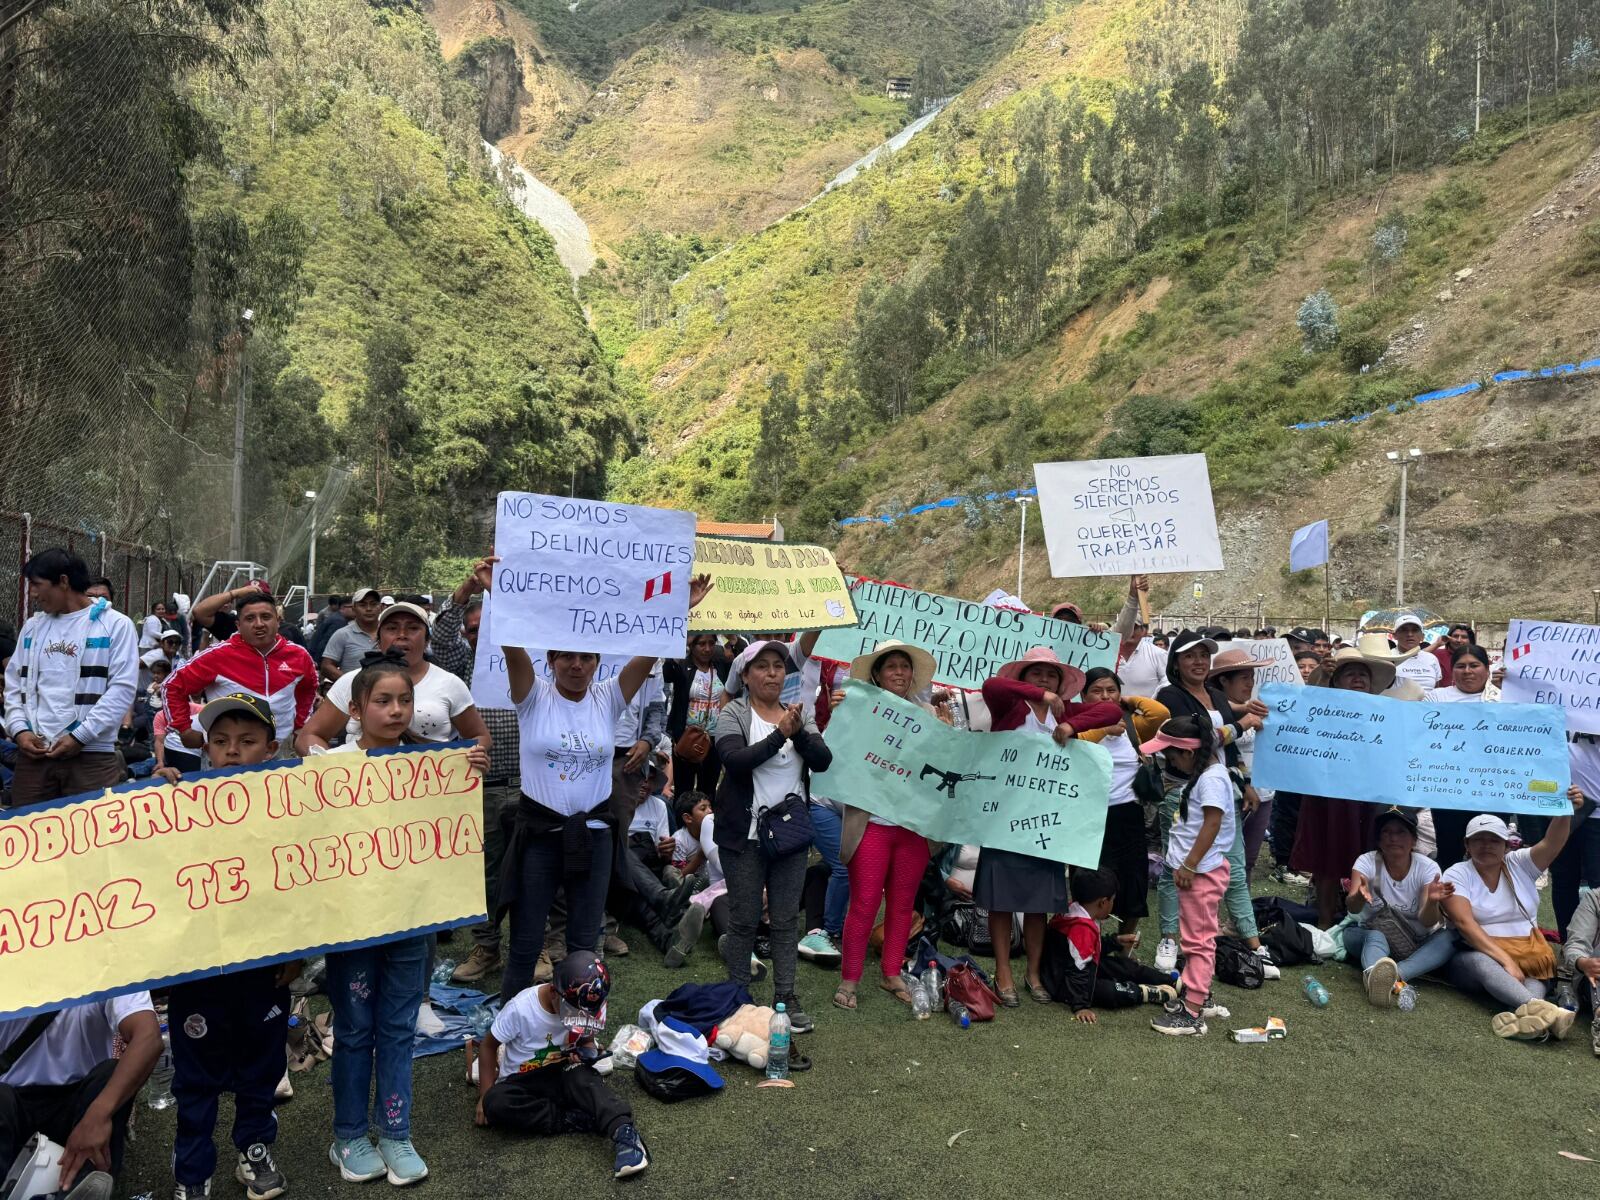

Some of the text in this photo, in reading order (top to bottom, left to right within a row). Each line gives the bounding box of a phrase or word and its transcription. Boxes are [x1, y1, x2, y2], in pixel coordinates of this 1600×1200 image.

[1109, 464, 1131, 478] NO
[1087, 476, 1161, 494] SEREMOS
[503, 497, 628, 525] NO SOMOS
[1074, 489, 1180, 510] SILENCIADOS
[1077, 518, 1176, 540] QUEREMOS
[529, 530, 692, 564] DELINCUENTES
[693, 541, 830, 569] REMOS LA PAZ
[1078, 534, 1178, 560] TRABAJAR
[499, 568, 621, 597] QUEREMOS
[715, 575, 842, 596] QUEREMOS LA VIDA
[568, 608, 686, 639] TRABAJAR
[706, 610, 718, 620] no
[723, 611, 733, 620] se
[738, 608, 763, 624] apague
[771, 608, 790, 620] otra
[955, 600, 1026, 633] TODOS
[1034, 617, 1112, 651] JUNTOS
[883, 613, 905, 639] LA
[913, 618, 954, 650] PAZ,
[958, 629, 977, 653] O
[1277, 699, 1385, 723] El gobierno NO
[1276, 724, 1384, 745] puede combatir la
[1422, 710, 1553, 740] Porque la CORRUPCIÓN
[883, 734, 903, 750] AL
[1430, 742, 1443, 750] es
[1452, 741, 1467, 752] el
[1000, 748, 1070, 772] NO MAS
[1408, 757, 1423, 770] En
[264, 753, 484, 819] INCAPAZ
[1005, 774, 1079, 799] MUERTES
[1406, 773, 1449, 784] silencio
[1455, 777, 1470, 785] no
[1503, 781, 1523, 790] ORO
[1423, 785, 1463, 795] silencio
[1490, 791, 1505, 799] un
[1510, 792, 1538, 802] sobre
[982, 801, 999, 812] EN
[1010, 812, 1062, 832] PATAZ
[176, 857, 250, 910] TE
[272, 814, 485, 891] REPUDIA
